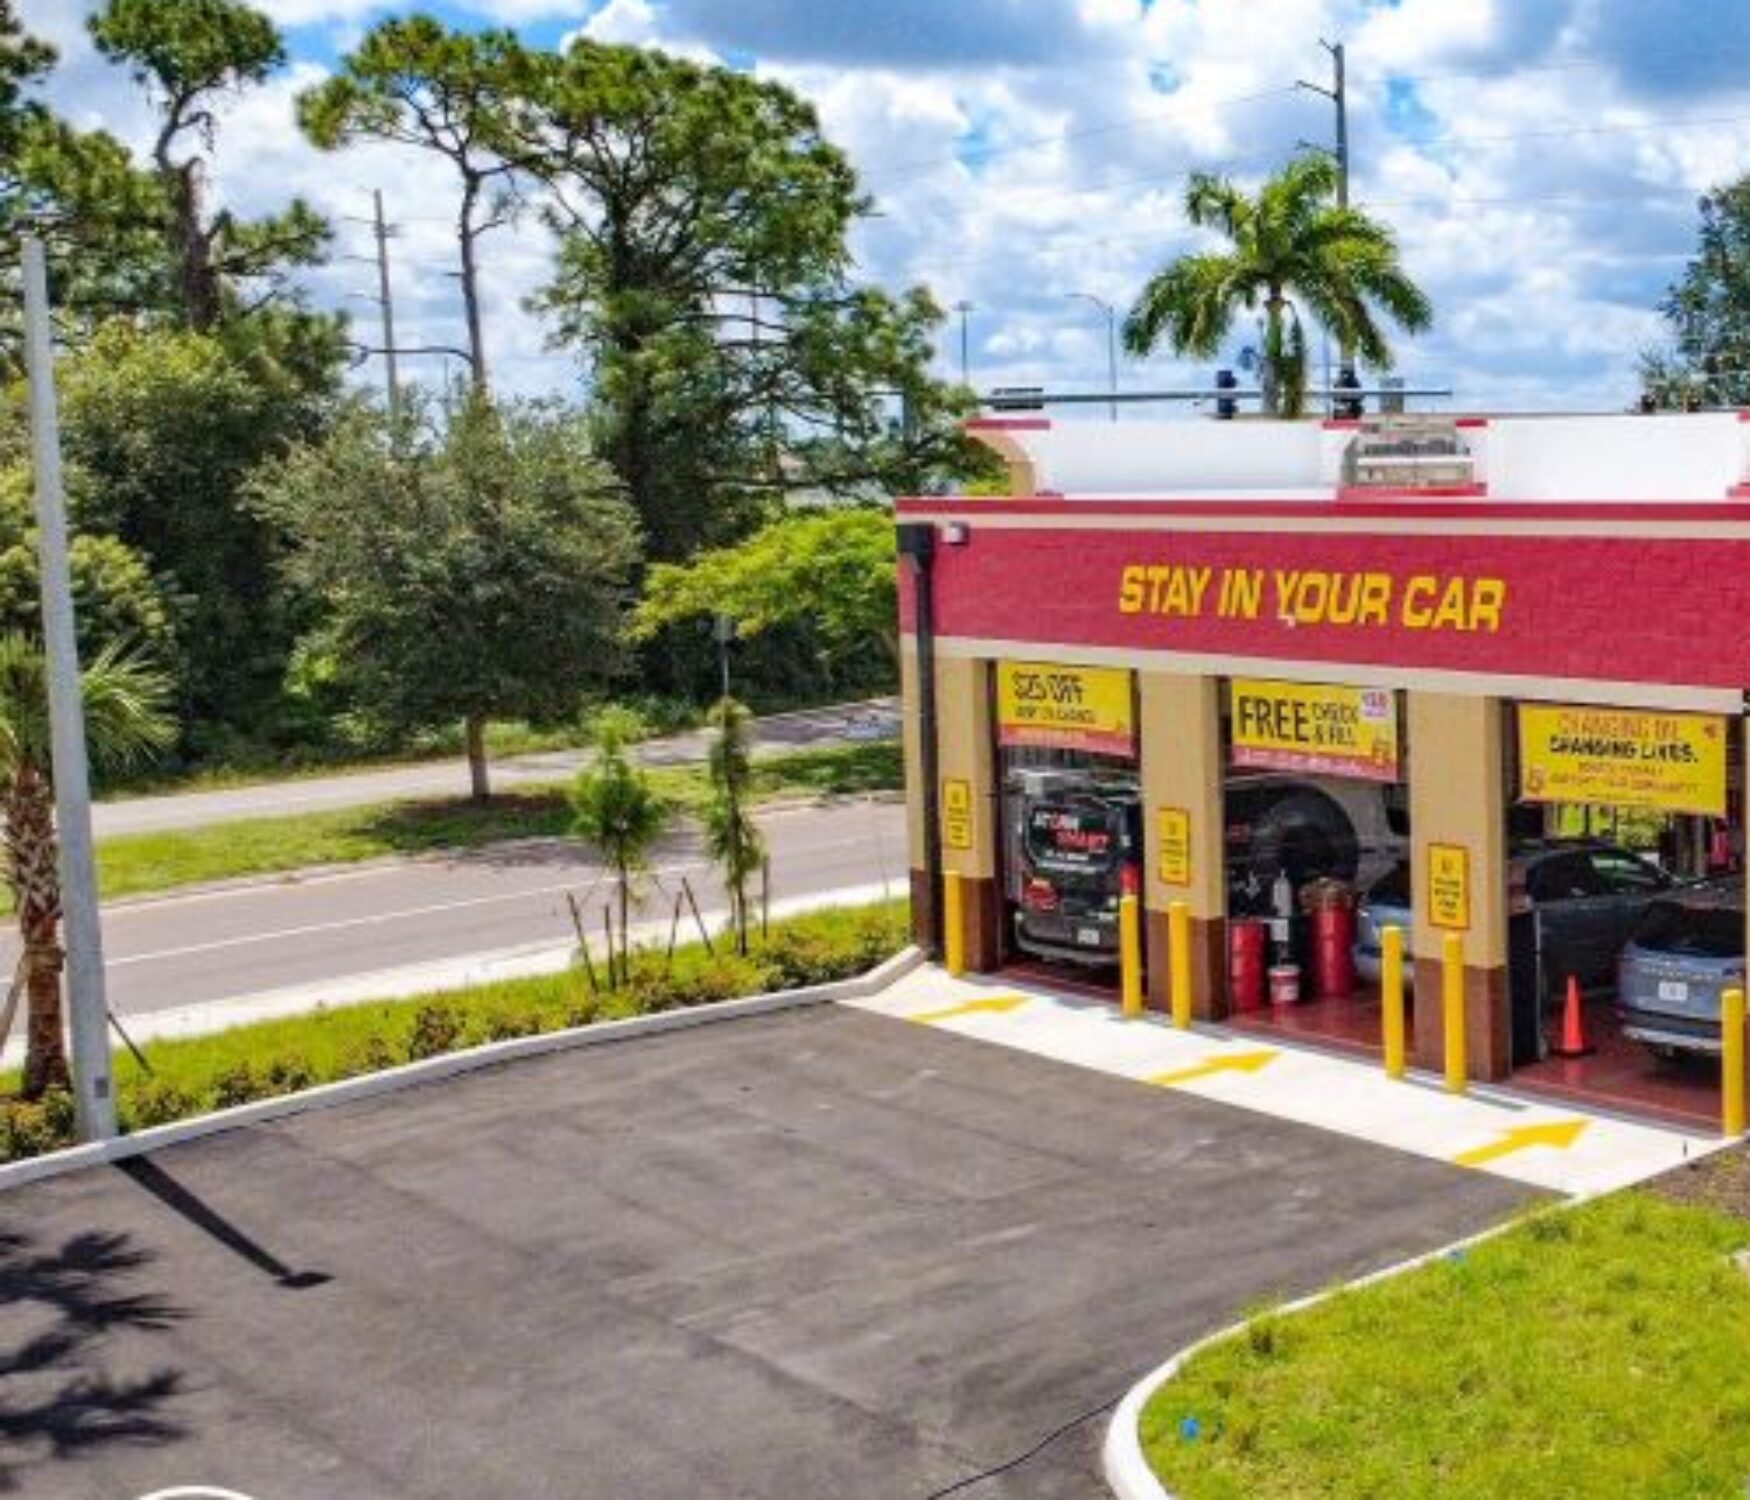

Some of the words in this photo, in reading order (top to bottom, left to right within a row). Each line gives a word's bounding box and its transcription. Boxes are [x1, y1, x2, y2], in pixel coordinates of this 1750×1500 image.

[1119, 565, 1211, 616] STAY
[1217, 569, 1264, 619] IN
[1275, 569, 1391, 625] YOUR
[1402, 575, 1505, 632] CAR
[1047, 673, 1084, 704] OFF
[1238, 695, 1310, 743] FREE
[1312, 701, 1359, 725] CHECK
[1550, 735, 1638, 759] CHANGING
[1640, 744, 1699, 763] LIVES.
